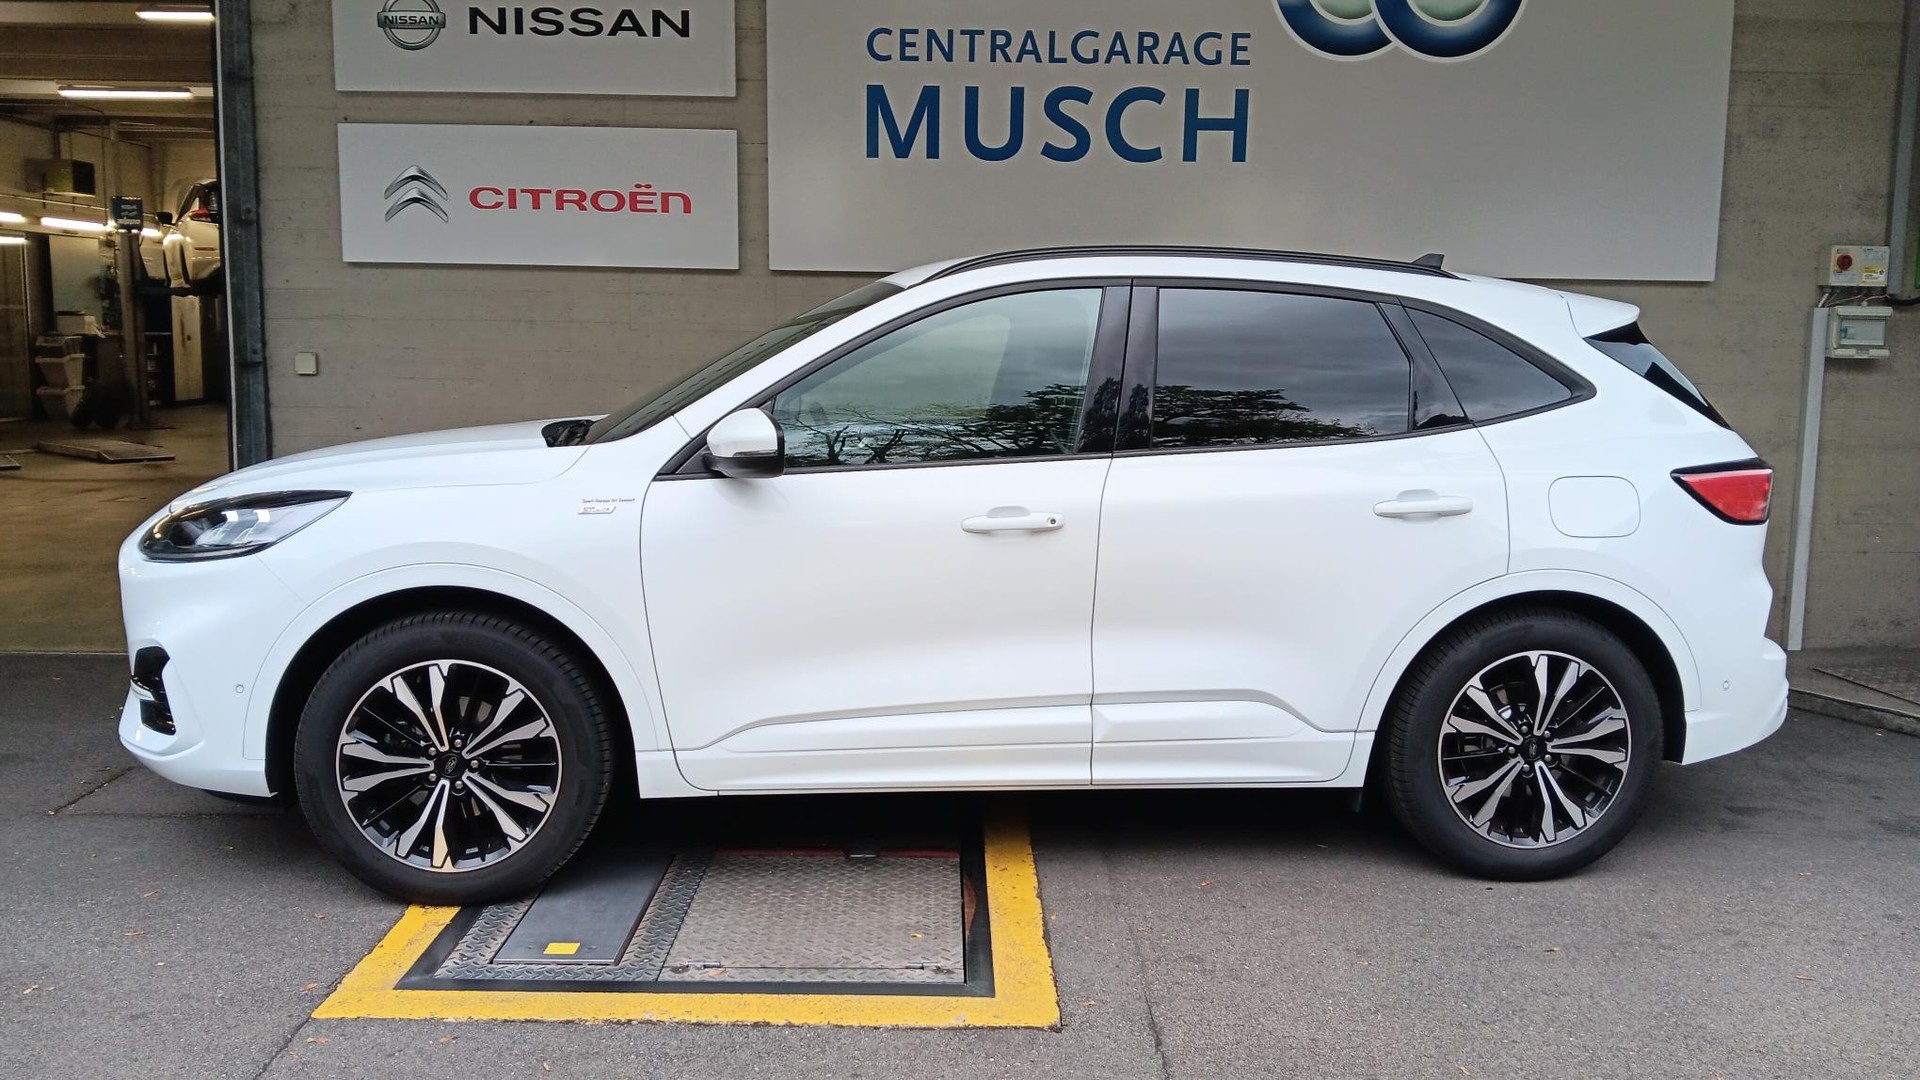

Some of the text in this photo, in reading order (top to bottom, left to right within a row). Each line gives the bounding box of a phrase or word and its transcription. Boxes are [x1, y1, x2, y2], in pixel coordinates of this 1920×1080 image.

[384, 15, 439, 25] NISSAN
[468, 6, 691, 38] NISSAN
[867, 28, 1251, 66] CENTRALGARAGE
[866, 84, 1249, 163] MUSCH
